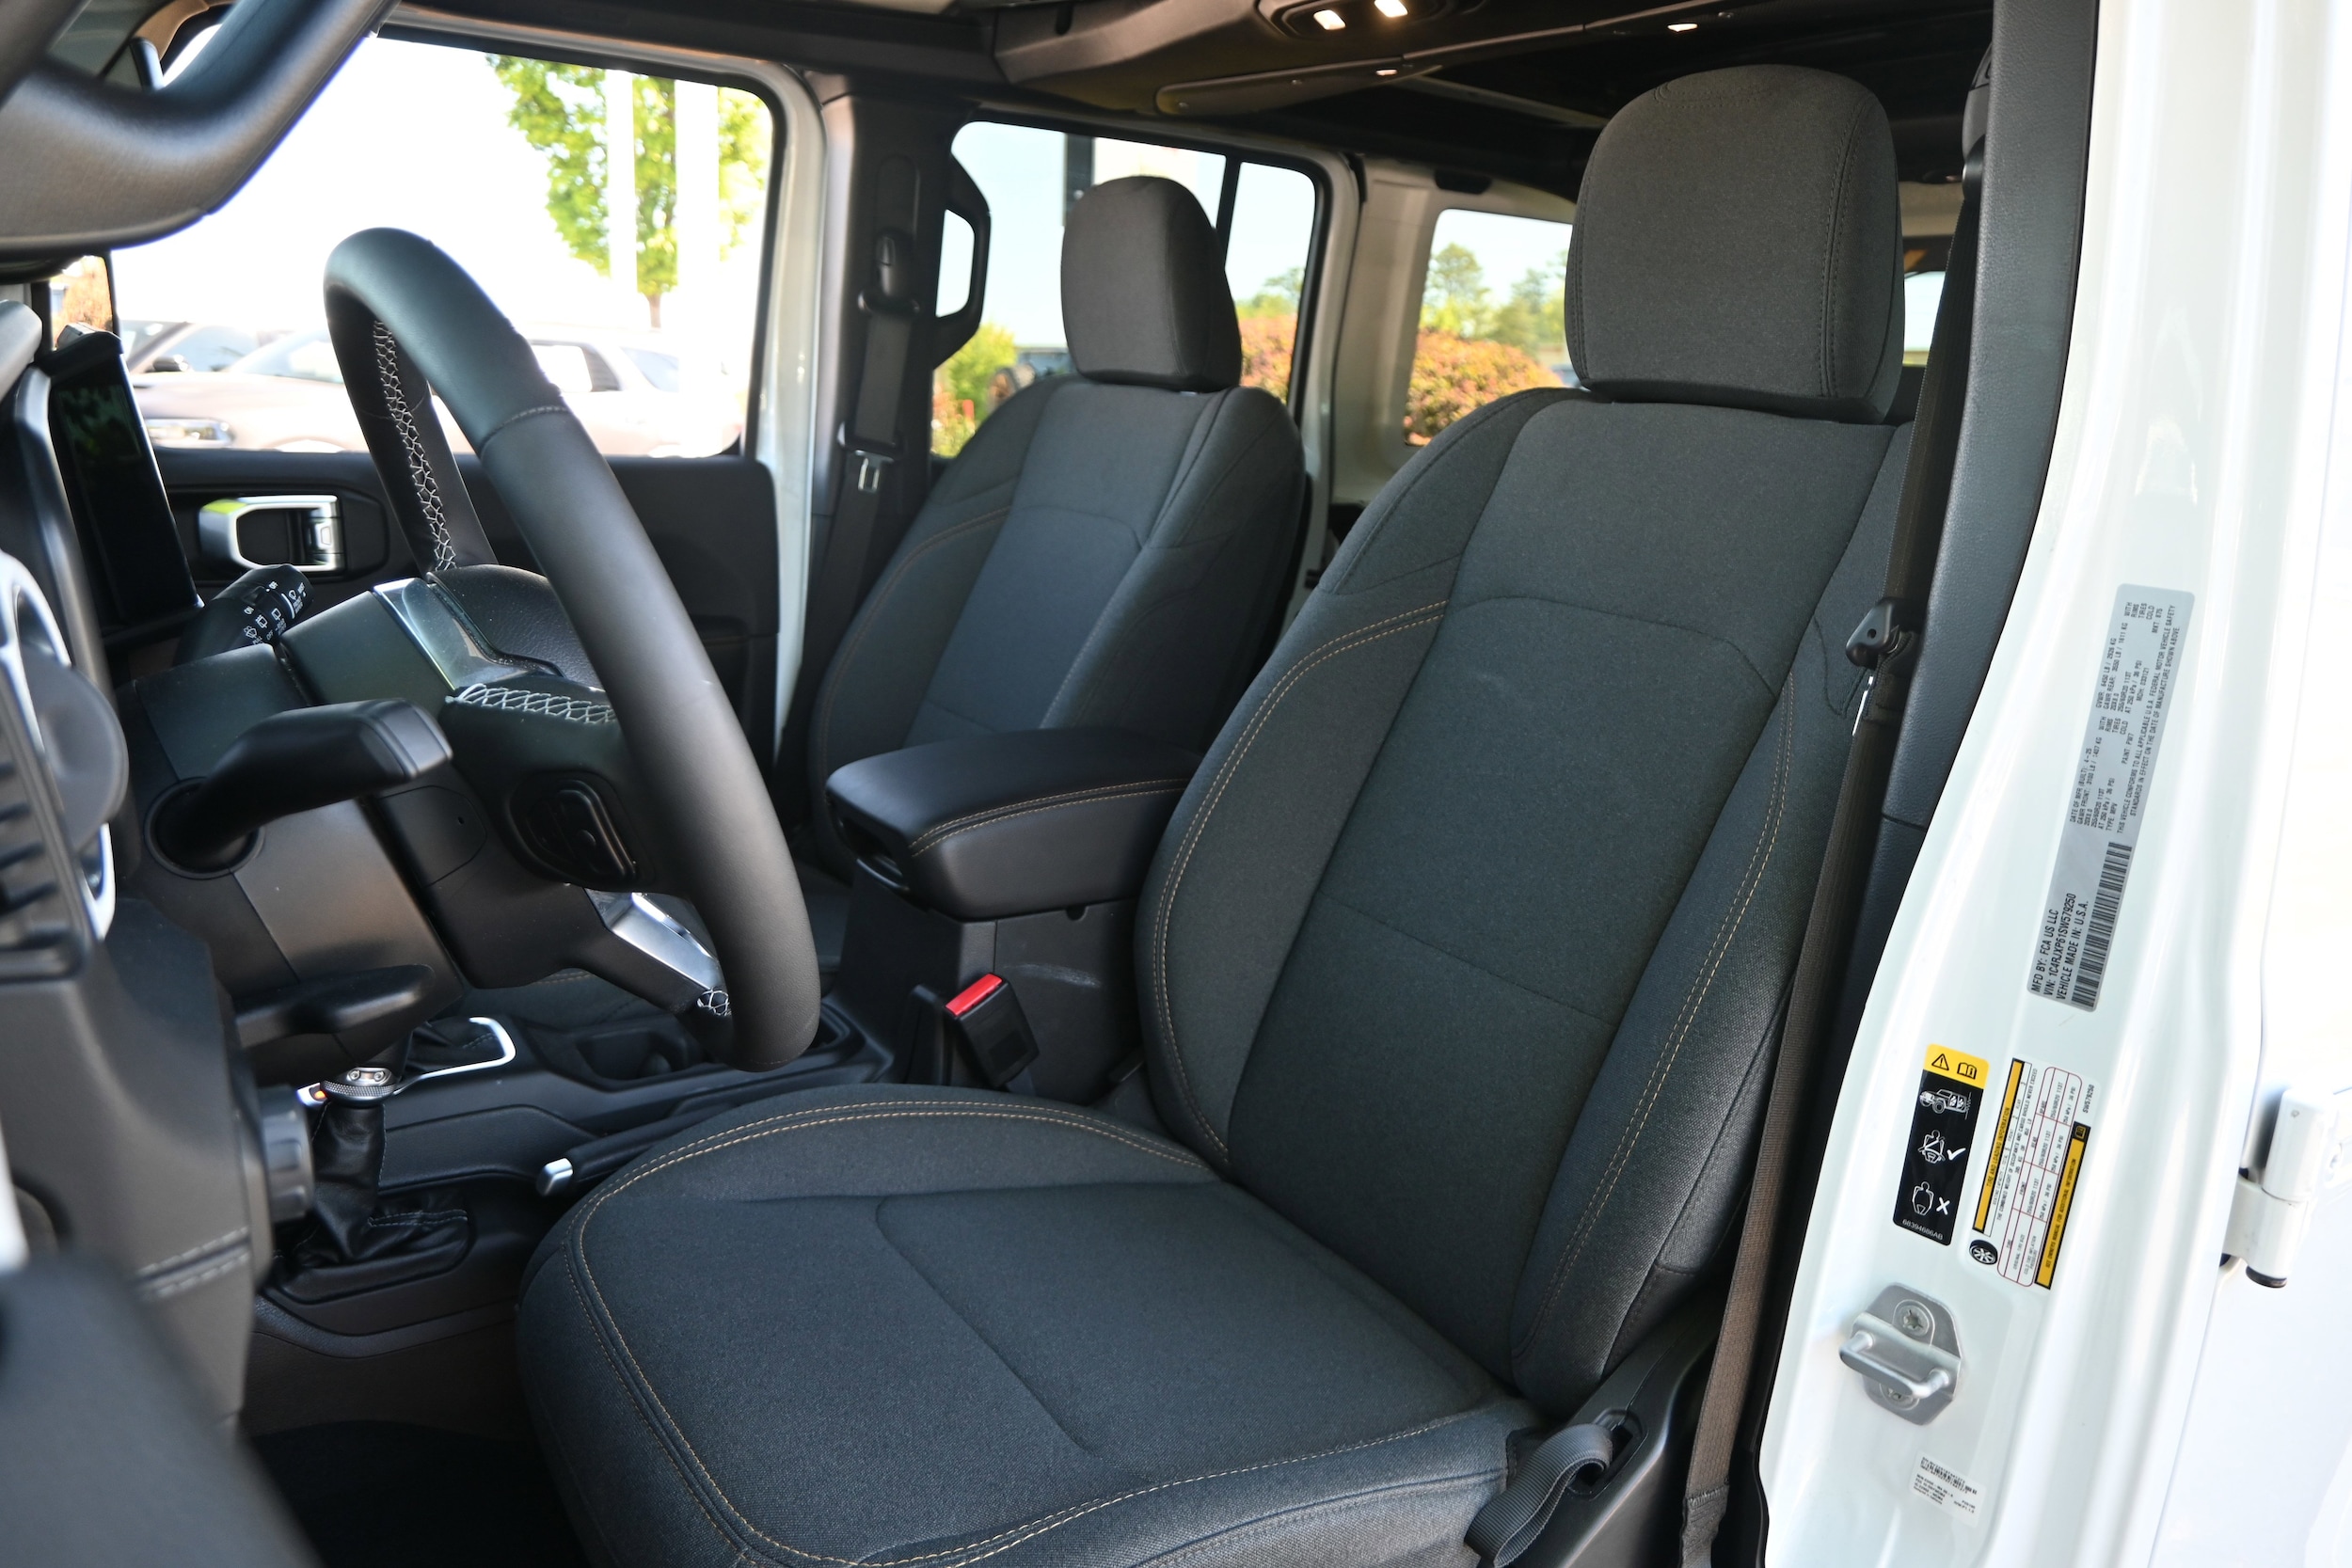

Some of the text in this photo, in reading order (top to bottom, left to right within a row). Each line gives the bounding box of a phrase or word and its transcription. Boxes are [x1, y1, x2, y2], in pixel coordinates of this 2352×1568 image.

[2131, 604, 2139, 618] RIMS
[2137, 603, 2147, 618] TIRES
[2146, 605, 2154, 620] COLD
[2165, 605, 2175, 626] SAFETY
[2160, 627, 2170, 650] VEHICLE
[2106, 647, 2115, 659] 2926
[2155, 651, 2165, 671] MOTOR
[2165, 646, 2175, 667] SHOWN
[2103, 693, 2111, 709] GAWR
[2111, 659, 2120, 672] 3550
[2126, 695, 2135, 705] 250
[2134, 660, 2142, 670] PSI
[2149, 673, 2160, 696] FEDERAL
[2155, 669, 2169, 709] MANUFACTURE
[2098, 716, 2106, 730] WITH
[2153, 710, 2160, 719] OF
[2105, 719, 2113, 732] RIMS
[2112, 718, 2122, 733] TIRES
[2120, 721, 2128, 735] COLD
[2137, 717, 2150, 748] APPLICABLE
[2149, 720, 2158, 734] DATE
[2146, 735, 2155, 745] THE
[2135, 750, 2143, 759] ALL
[2144, 747, 2152, 755] ON
[2138, 756, 2149, 776] EFFECT
[2125, 769, 2137, 798] CONFORMS
[2070, 809, 2078, 823] DATE
[2074, 787, 2083, 800] MFR
[2102, 800, 2110, 811] kPa
[2109, 802, 2118, 815] MPV
[2121, 800, 2131, 820] VEHICLE
[2130, 784, 2142, 816] STANDARDS
[2076, 808, 2085, 825] GAWR
[2117, 821, 2125, 833] THIS
[2031, 909, 2058, 992] MFD BY: FCA US LLC
[2043, 894, 2075, 995] VIN: 1C4RJXP61SW579250
[2057, 901, 2089, 1000] VEHICLE MADE IN: U.S.A.
[2082, 1085, 2094, 1114] SW579250
[1986, 1176, 1994, 1186] TIRE
[1993, 1142, 2002, 1164] LOADING
[1998, 1107, 2010, 1141] INFORMATION
[1999, 1192, 2008, 1212] COMBINED
[2010, 1143, 2019, 1166] OCCUPANTS
[2022, 1101, 2030, 1117] SHOULD
[2029, 1069, 2038, 1085] EXCEED
[2052, 1225, 2060, 1241] MANUAL
[2059, 1189, 2069, 1213] ADDITIONAL
[2066, 1159, 2076, 1186] INFORMATION
